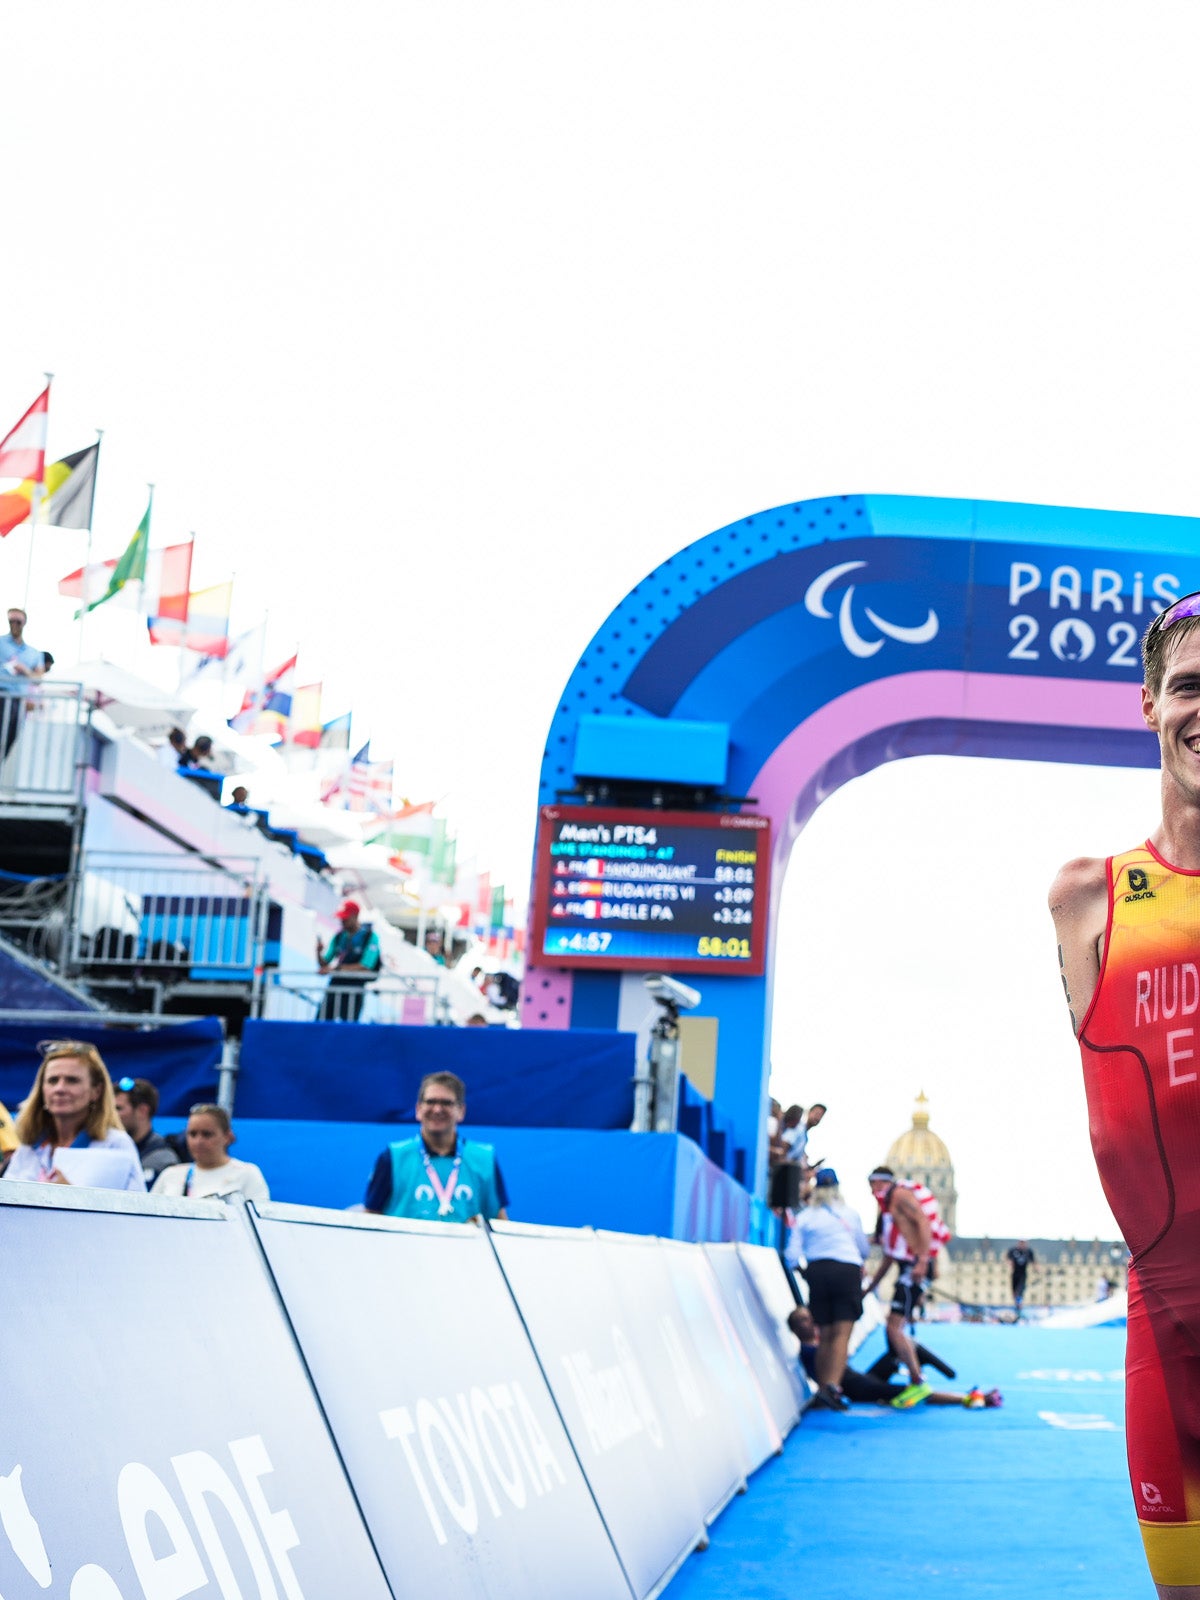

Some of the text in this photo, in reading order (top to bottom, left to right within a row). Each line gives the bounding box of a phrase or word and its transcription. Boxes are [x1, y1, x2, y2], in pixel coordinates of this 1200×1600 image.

[1008, 614, 1138, 667] 202
[559, 824, 657, 845] Men's PTS4
[378, 1381, 567, 1545] TOYOTA
